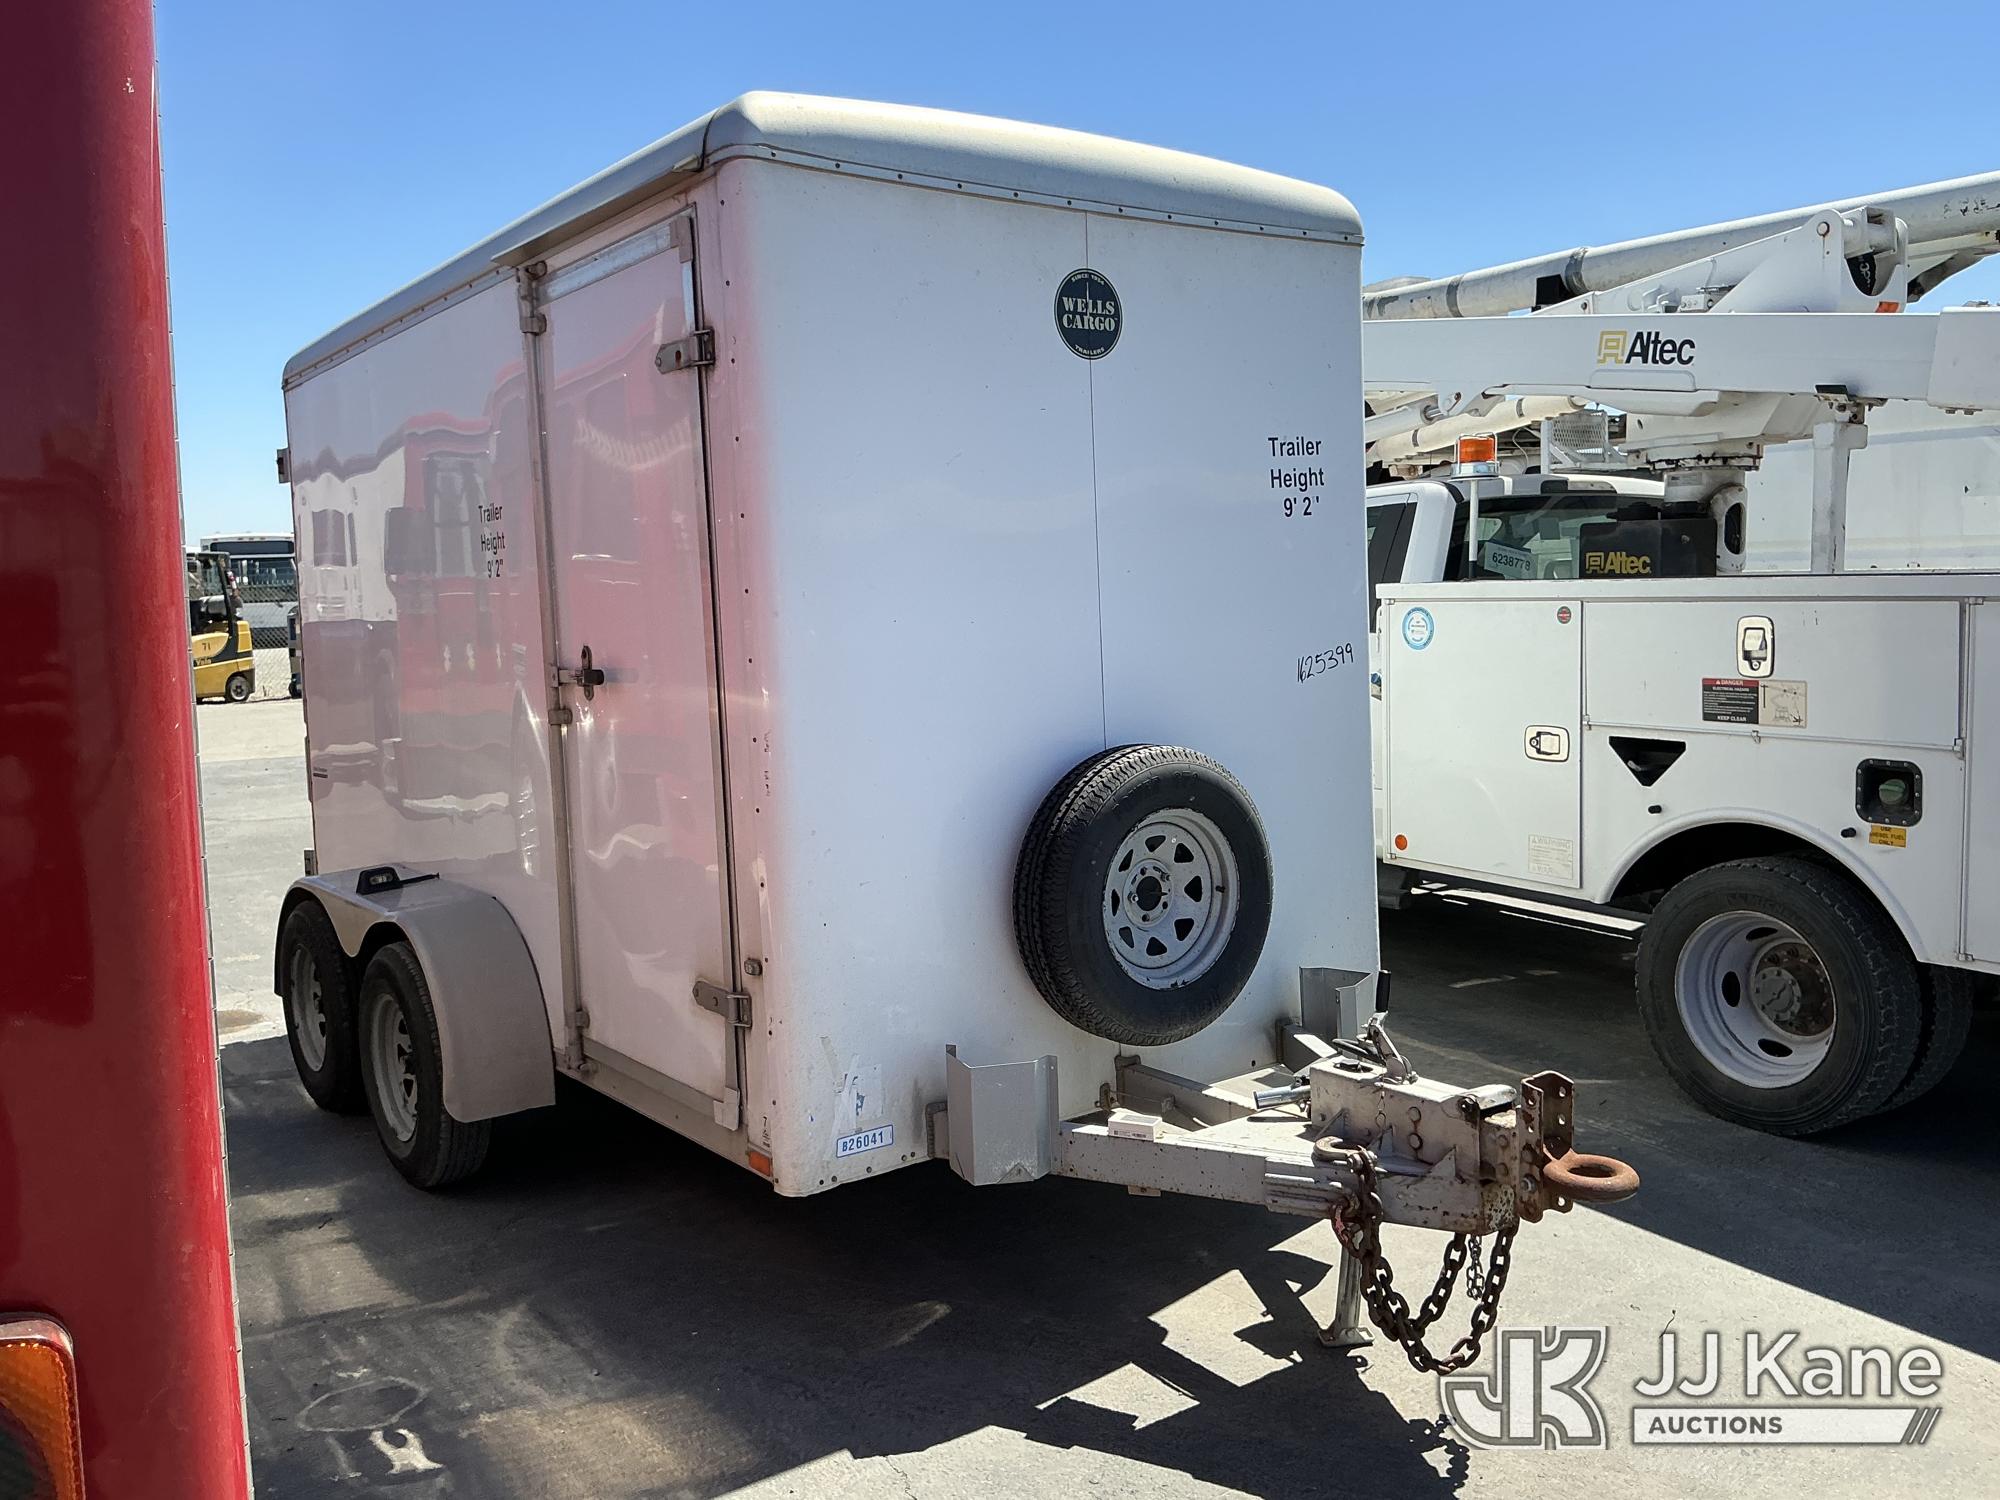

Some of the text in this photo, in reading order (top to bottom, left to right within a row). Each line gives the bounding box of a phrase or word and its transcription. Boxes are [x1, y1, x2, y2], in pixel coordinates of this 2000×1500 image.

[1062, 296, 1115, 315] WELLS
[1062, 313, 1116, 331] CARGO
[1625, 331, 1696, 365] Altec
[1268, 436, 1321, 456] Trailer
[1270, 467, 1324, 492] Height
[478, 503, 502, 523] Trailer
[1283, 497, 1297, 517] 9'
[480, 532, 505, 555] Height
[1492, 552, 1531, 571] 6238778
[1605, 551, 1652, 574] Altec
[1297, 642, 1354, 684] 1625399
[842, 1131, 884, 1152] B26041
